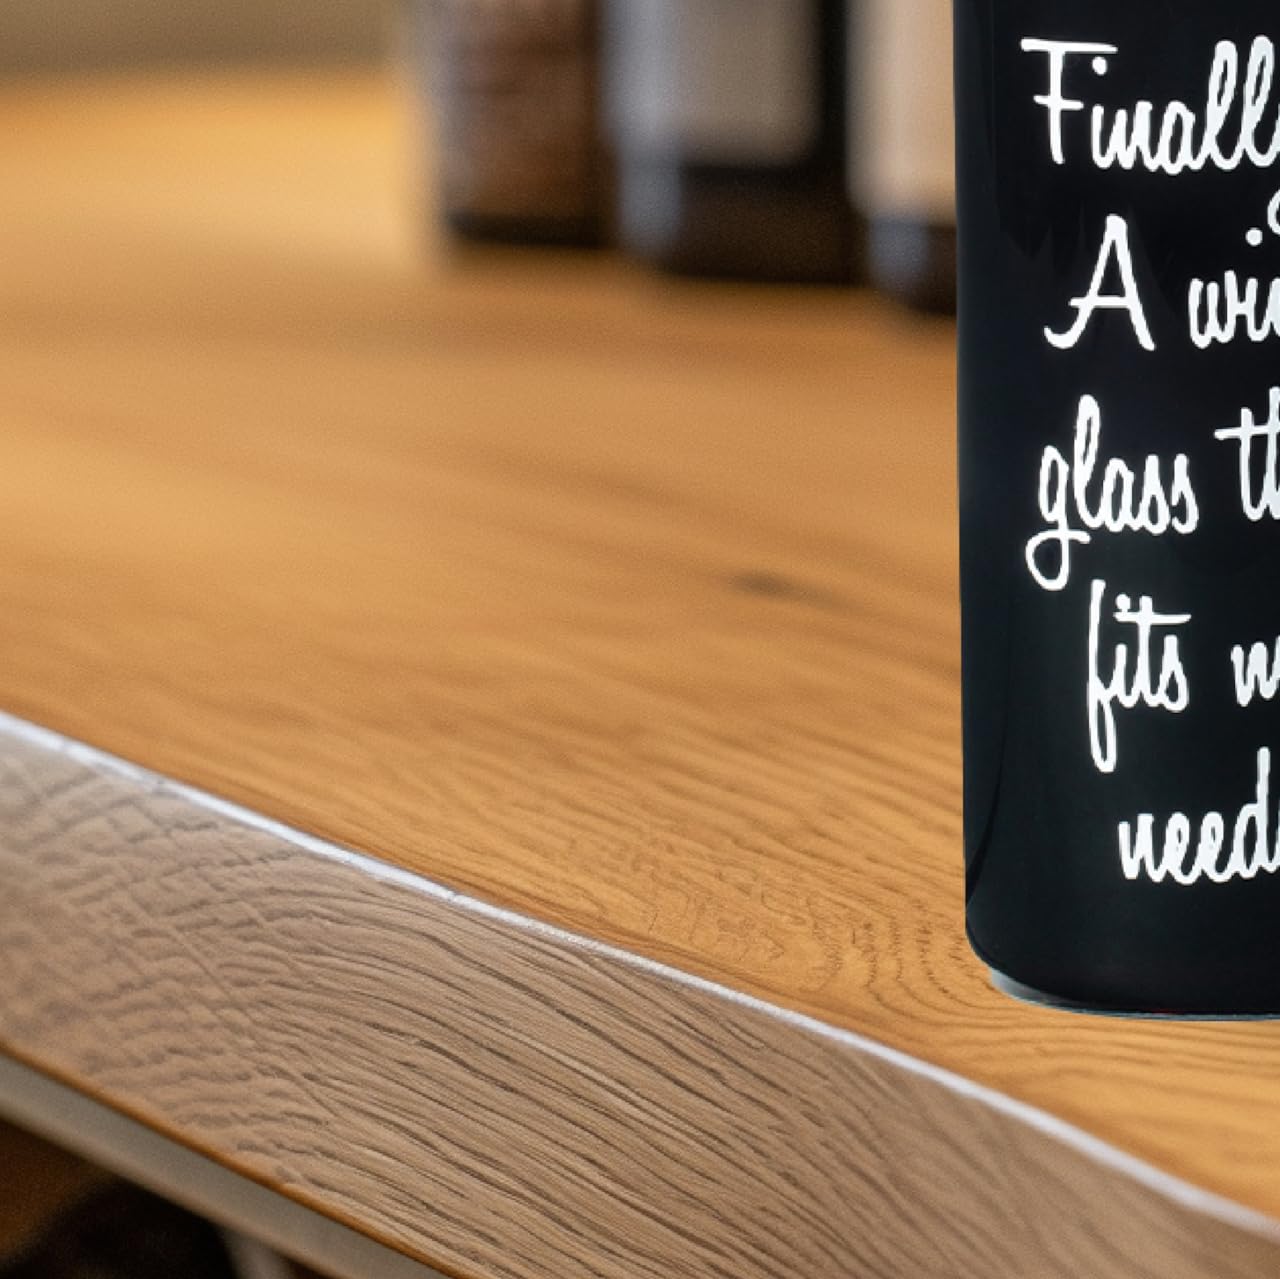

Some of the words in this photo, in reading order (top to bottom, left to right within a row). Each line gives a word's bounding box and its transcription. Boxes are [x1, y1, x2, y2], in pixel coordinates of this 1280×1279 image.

[1043, 213, 1156, 352] A
[1024, 394, 1200, 592] glass
[1086, 578, 1192, 774] fits
